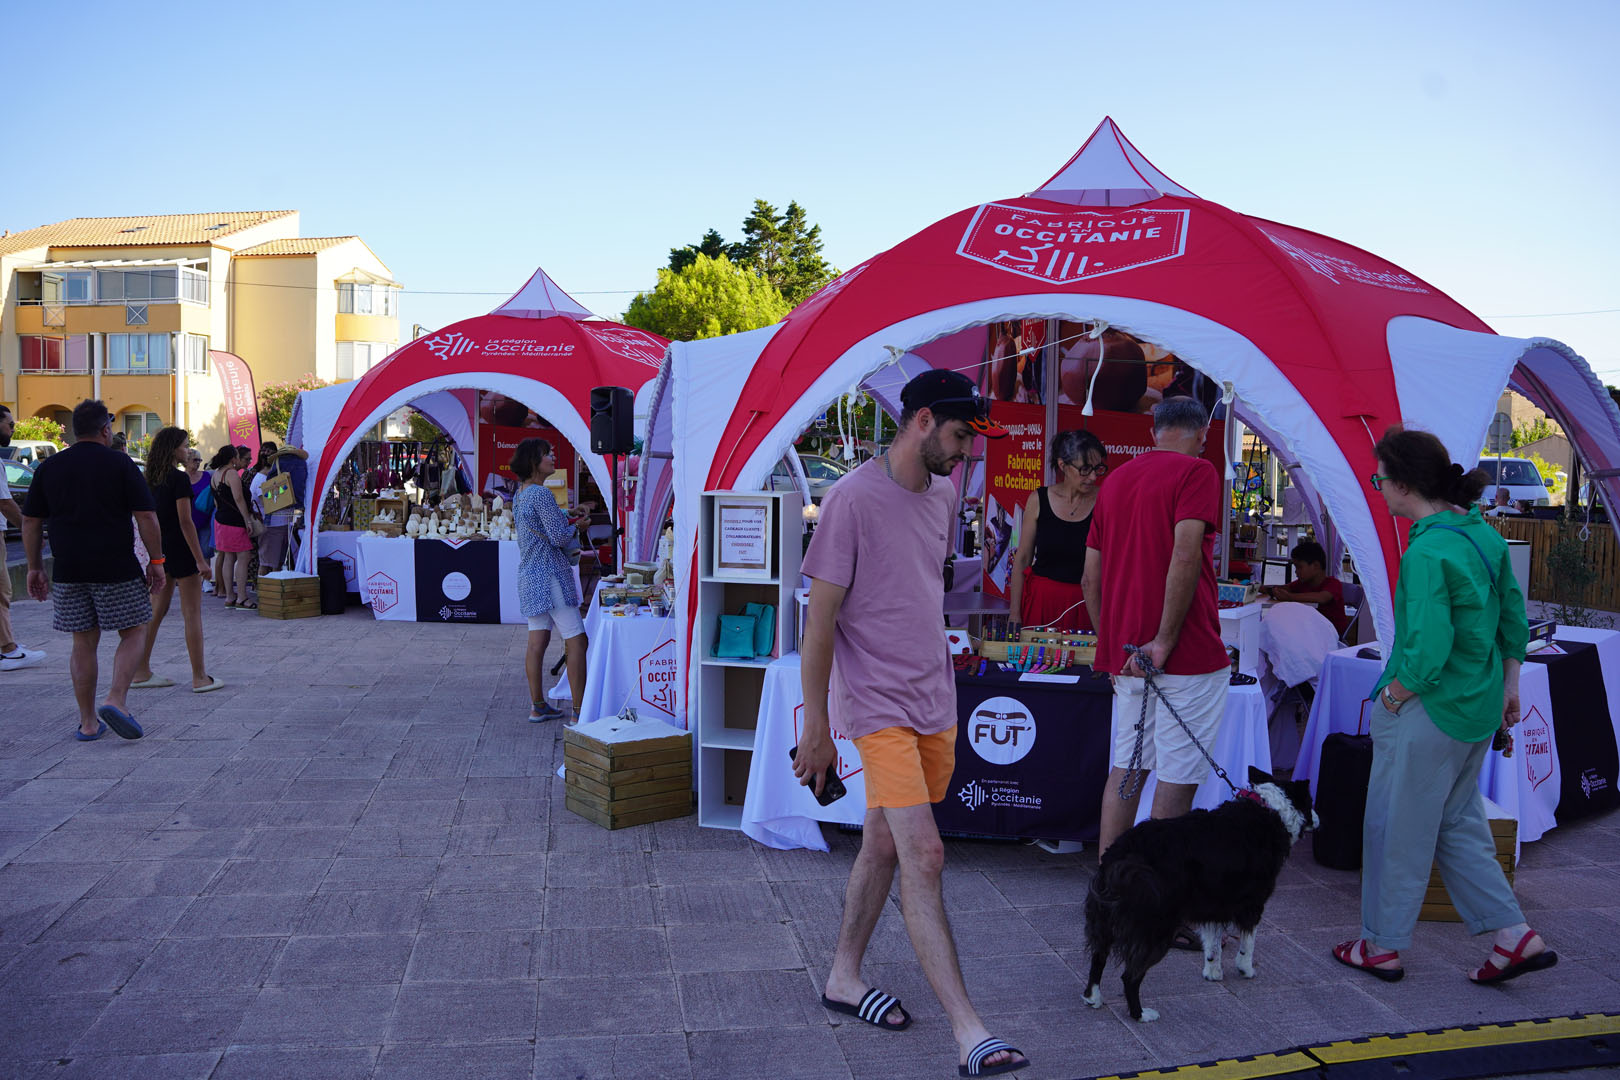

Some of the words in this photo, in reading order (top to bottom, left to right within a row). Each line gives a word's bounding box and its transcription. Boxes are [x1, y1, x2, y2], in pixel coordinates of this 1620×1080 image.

[1011, 213, 1156, 229] FABRIQUÉ
[994, 223, 1162, 244] OCCITANIE
[484, 343, 576, 352] Occitanie
[1021, 440, 1036, 450] avec
[1036, 438, 1042, 450] le
[1007, 452, 1042, 474] Fabriqué
[994, 475, 1004, 487] en
[1005, 472, 1041, 491] Occitanie
[648, 672, 677, 682] OCCIT
[991, 793, 1042, 805] Occitanie
